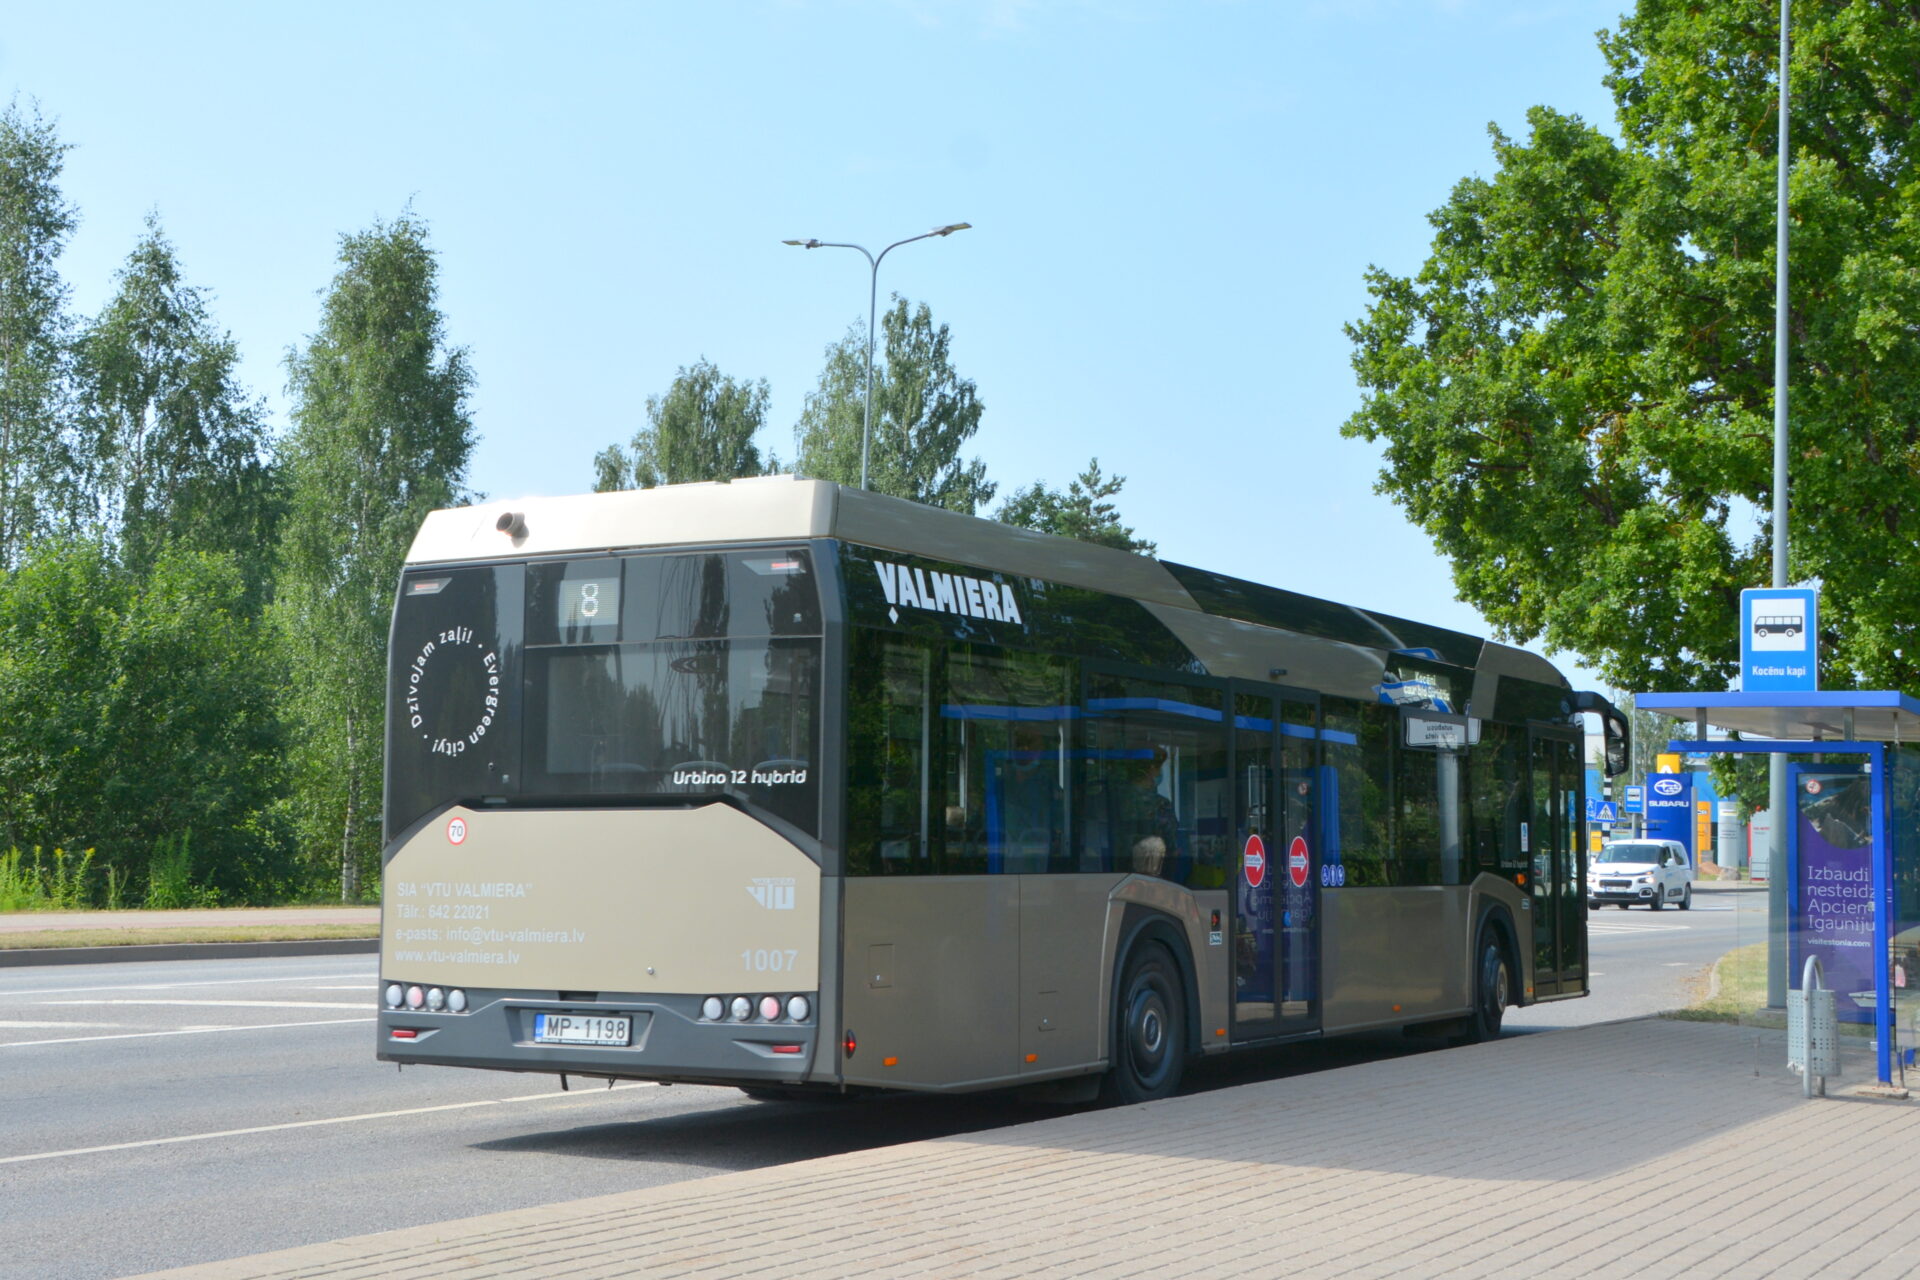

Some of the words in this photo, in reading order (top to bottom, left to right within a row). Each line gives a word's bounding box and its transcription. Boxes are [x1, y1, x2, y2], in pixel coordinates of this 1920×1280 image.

[581, 584, 599, 617] 8
[874, 561, 1022, 625] VALMIERA
[407, 642, 435, 728] Dzīvojam
[439, 626, 473, 645] zaļi!
[1752, 664, 1785, 676] Kocēnu
[1786, 665, 1806, 678] kapi
[469, 652, 499, 744] Evergreen
[432, 738, 465, 757] city!
[673, 770, 726, 784] Urbino
[731, 770, 747, 784] 12
[751, 770, 807, 787] hybrid
[1649, 800, 1689, 808] SUBARU
[451, 825, 464, 837] 70
[1808, 865, 1870, 882] Izbaudi
[397, 882, 417, 897] SIA
[429, 904, 449, 919] 642
[454, 905, 490, 920] 22021
[1807, 899, 1876, 915] Apciem
[395, 926, 442, 943] e-pasts:
[446, 926, 585, 945] info@vtu-valmiera.lv
[1807, 937, 1871, 948] visitestonia.com
[395, 949, 520, 965] www.vtu-valmiera.lv
[742, 949, 799, 972] 1007
[547, 1017, 626, 1039] MP-1198
